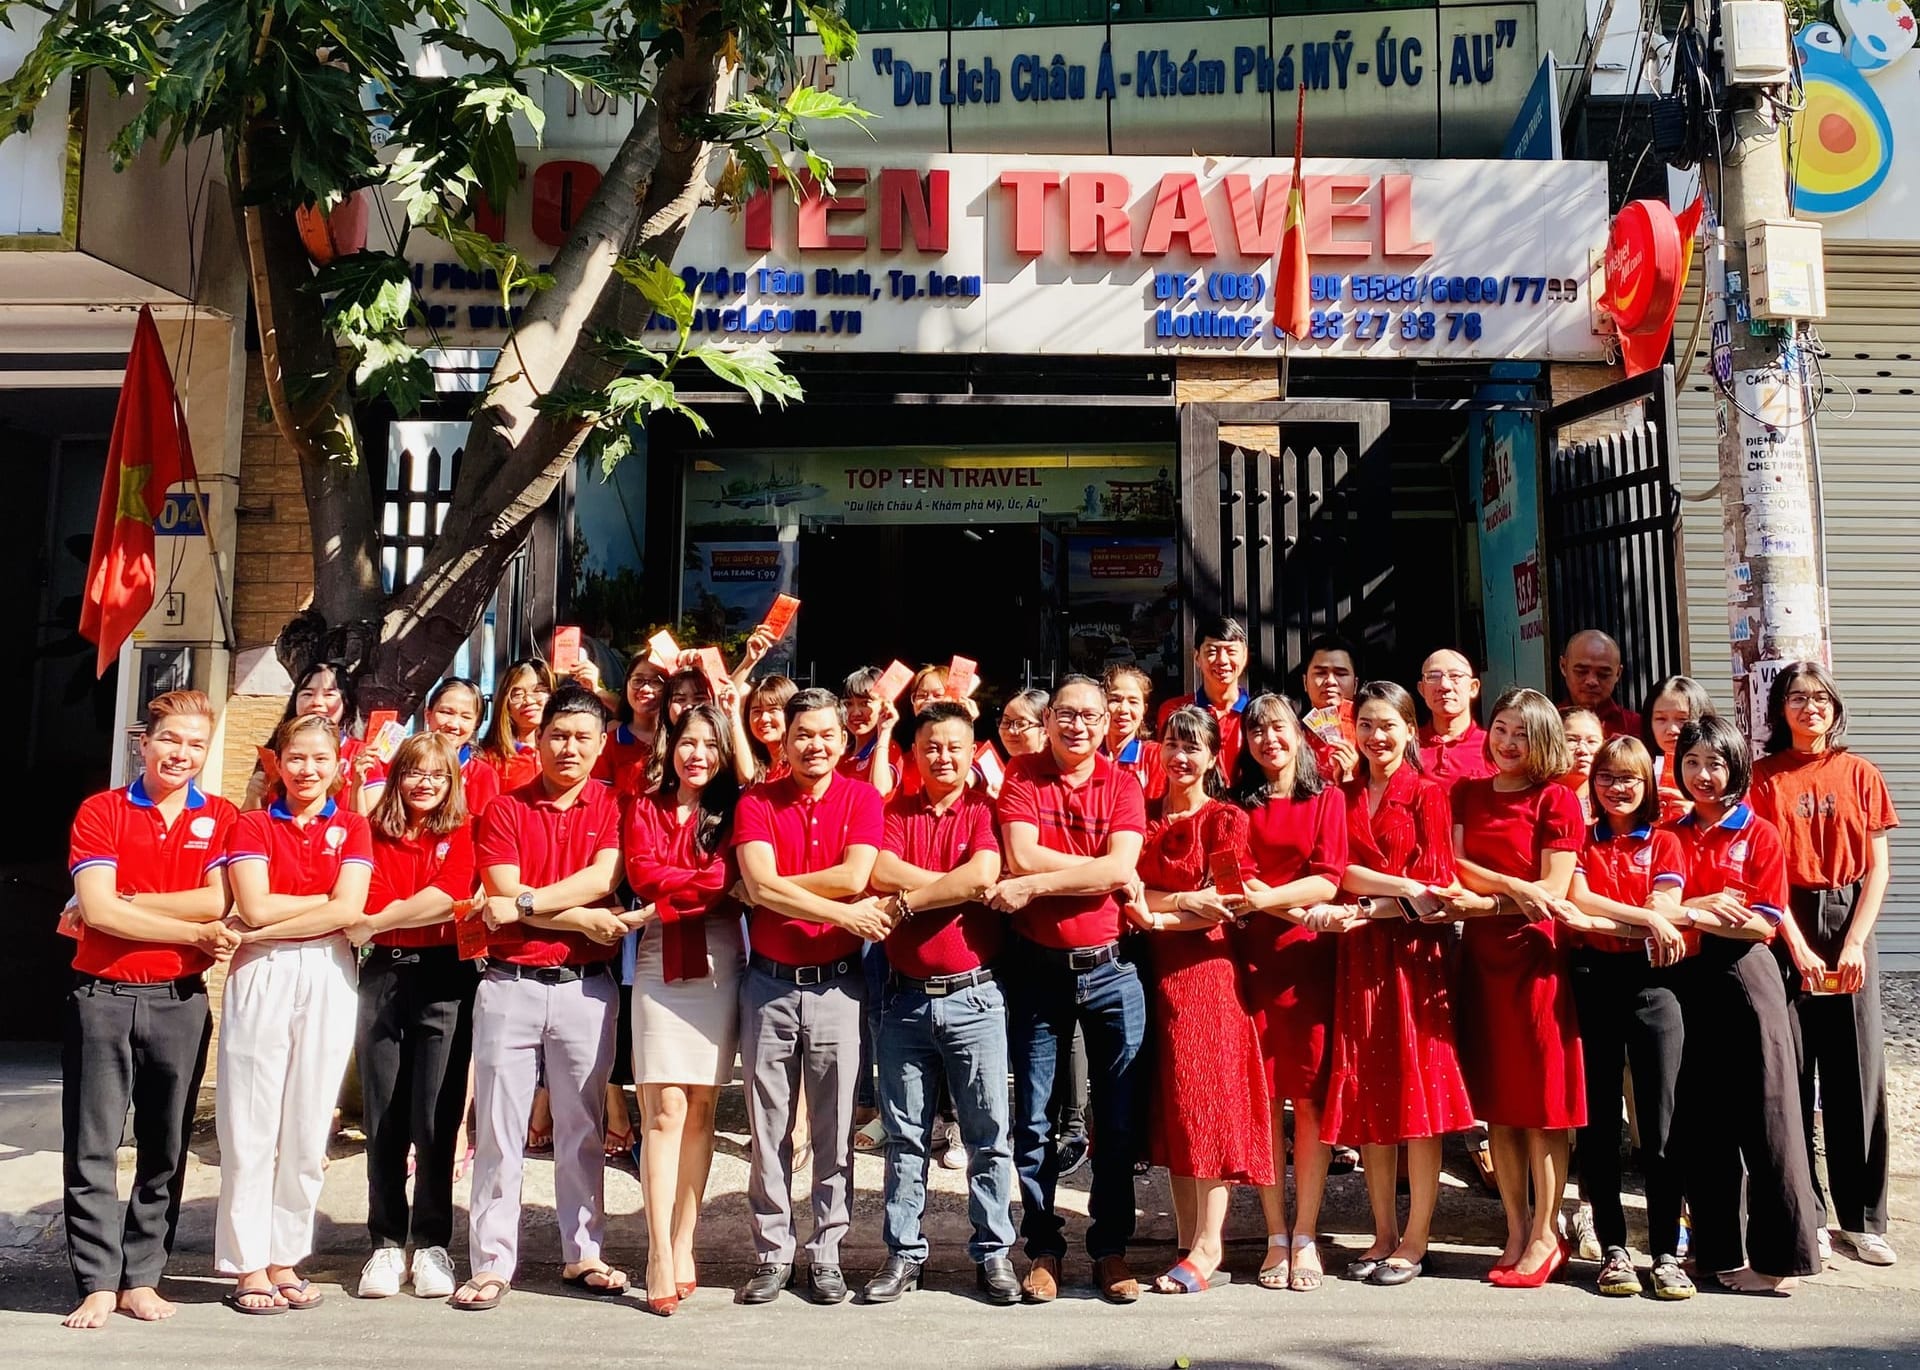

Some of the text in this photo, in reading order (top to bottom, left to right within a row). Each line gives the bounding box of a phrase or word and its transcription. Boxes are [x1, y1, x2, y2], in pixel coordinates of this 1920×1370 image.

[1010, 53, 1086, 102] Châu
[745, 166, 950, 252] TEN
[1000, 170, 1433, 257] TRAVEL
[757, 266, 805, 295] Tân
[1154, 272, 1197, 300] ĐT:
[1208, 271, 1266, 302] (08)
[1310, 273, 1343, 301] 90
[1156, 308, 1264, 339] Hotline:
[1354, 310, 1390, 341] 27
[1400, 311, 1436, 341] 33
[1446, 311, 1482, 342] 78
[844, 466, 1042, 489] TOP TEN TRAVEL
